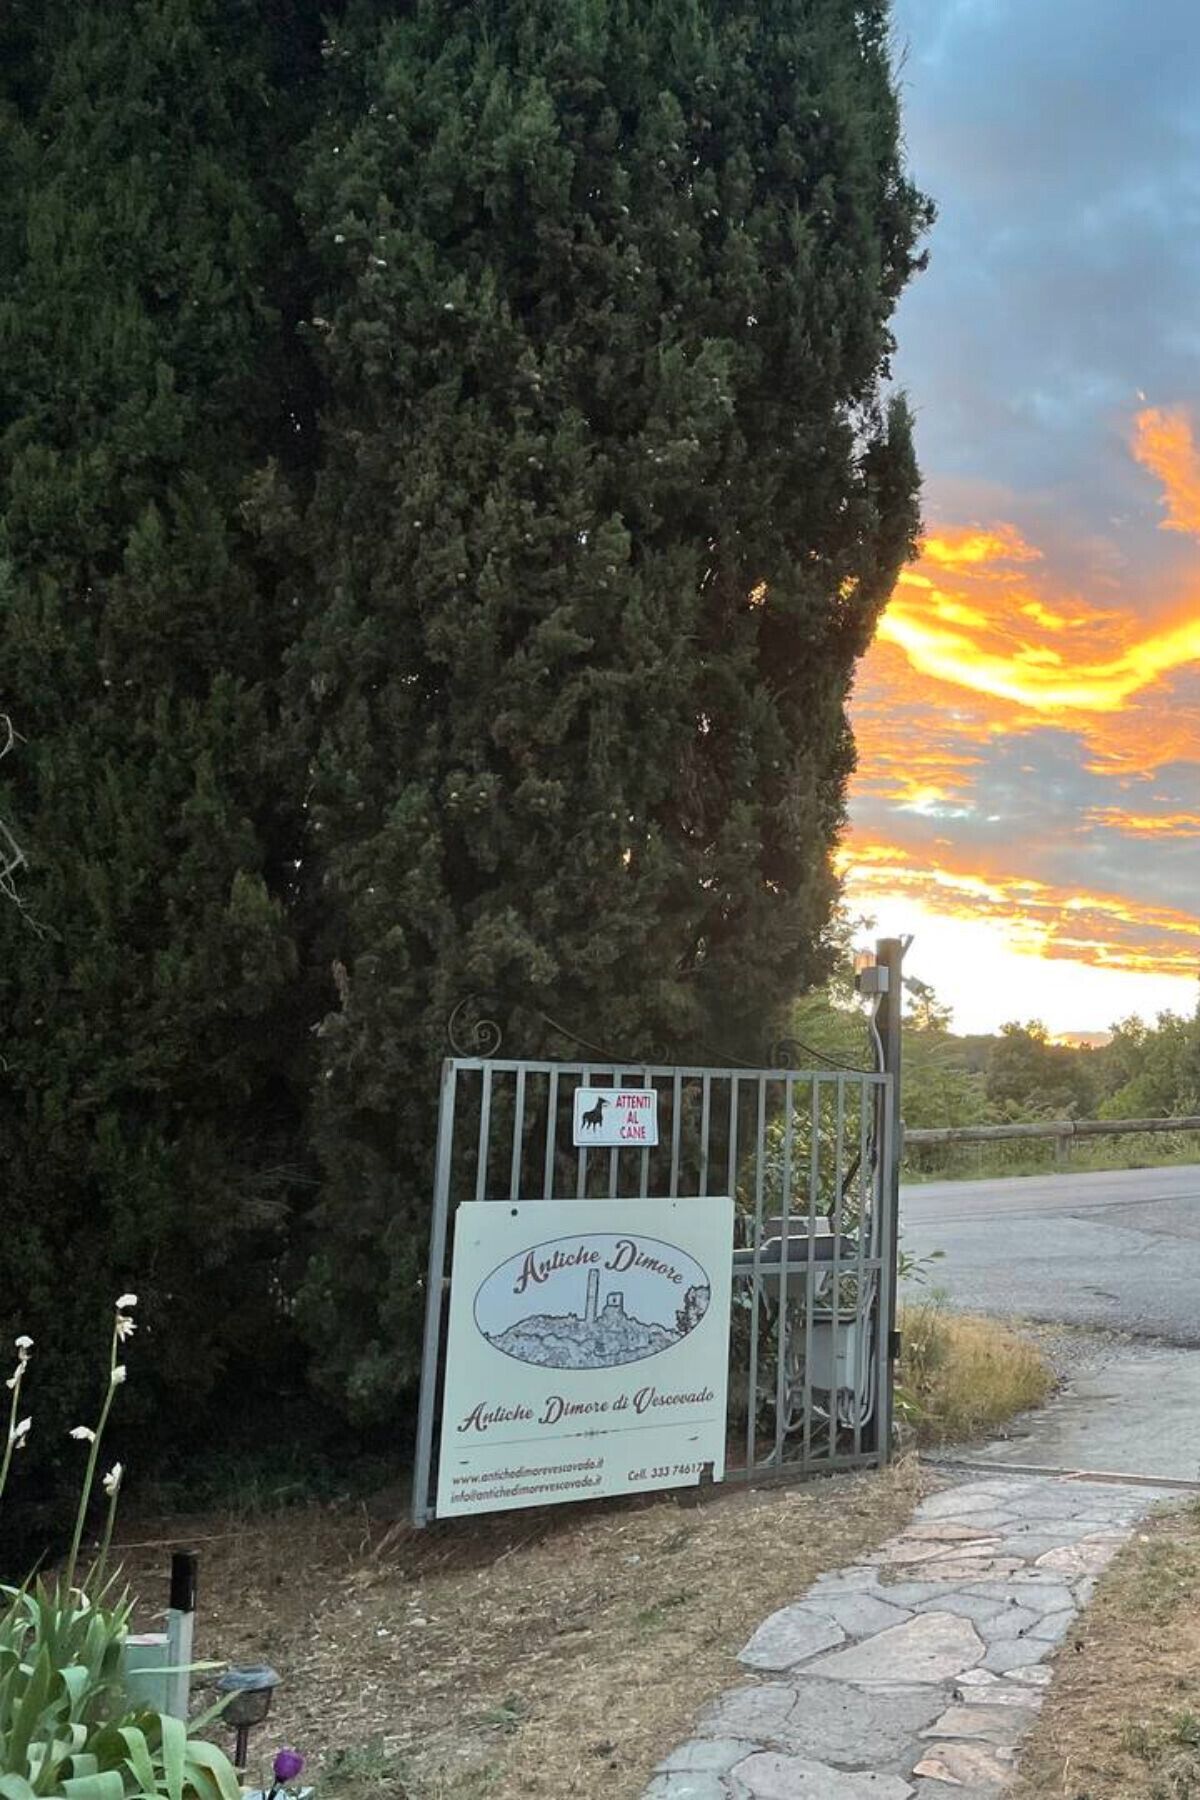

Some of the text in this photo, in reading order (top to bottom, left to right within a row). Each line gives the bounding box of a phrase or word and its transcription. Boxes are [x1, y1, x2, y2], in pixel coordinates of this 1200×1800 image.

[616, 1095, 650, 1109] ATTENTI
[626, 1111, 639, 1124] AL
[620, 1126, 646, 1139] CANE
[513, 1239, 684, 1294] Antiche Dimore
[457, 1386, 715, 1432] Antiche Dimore di Vescovado
[452, 1458, 605, 1484] www.antichedimorevescovado.it
[651, 1465, 670, 1478] 333
[672, 1461, 704, 1476] 74617
[450, 1474, 603, 1504] info@antichedimorevescovado.it
